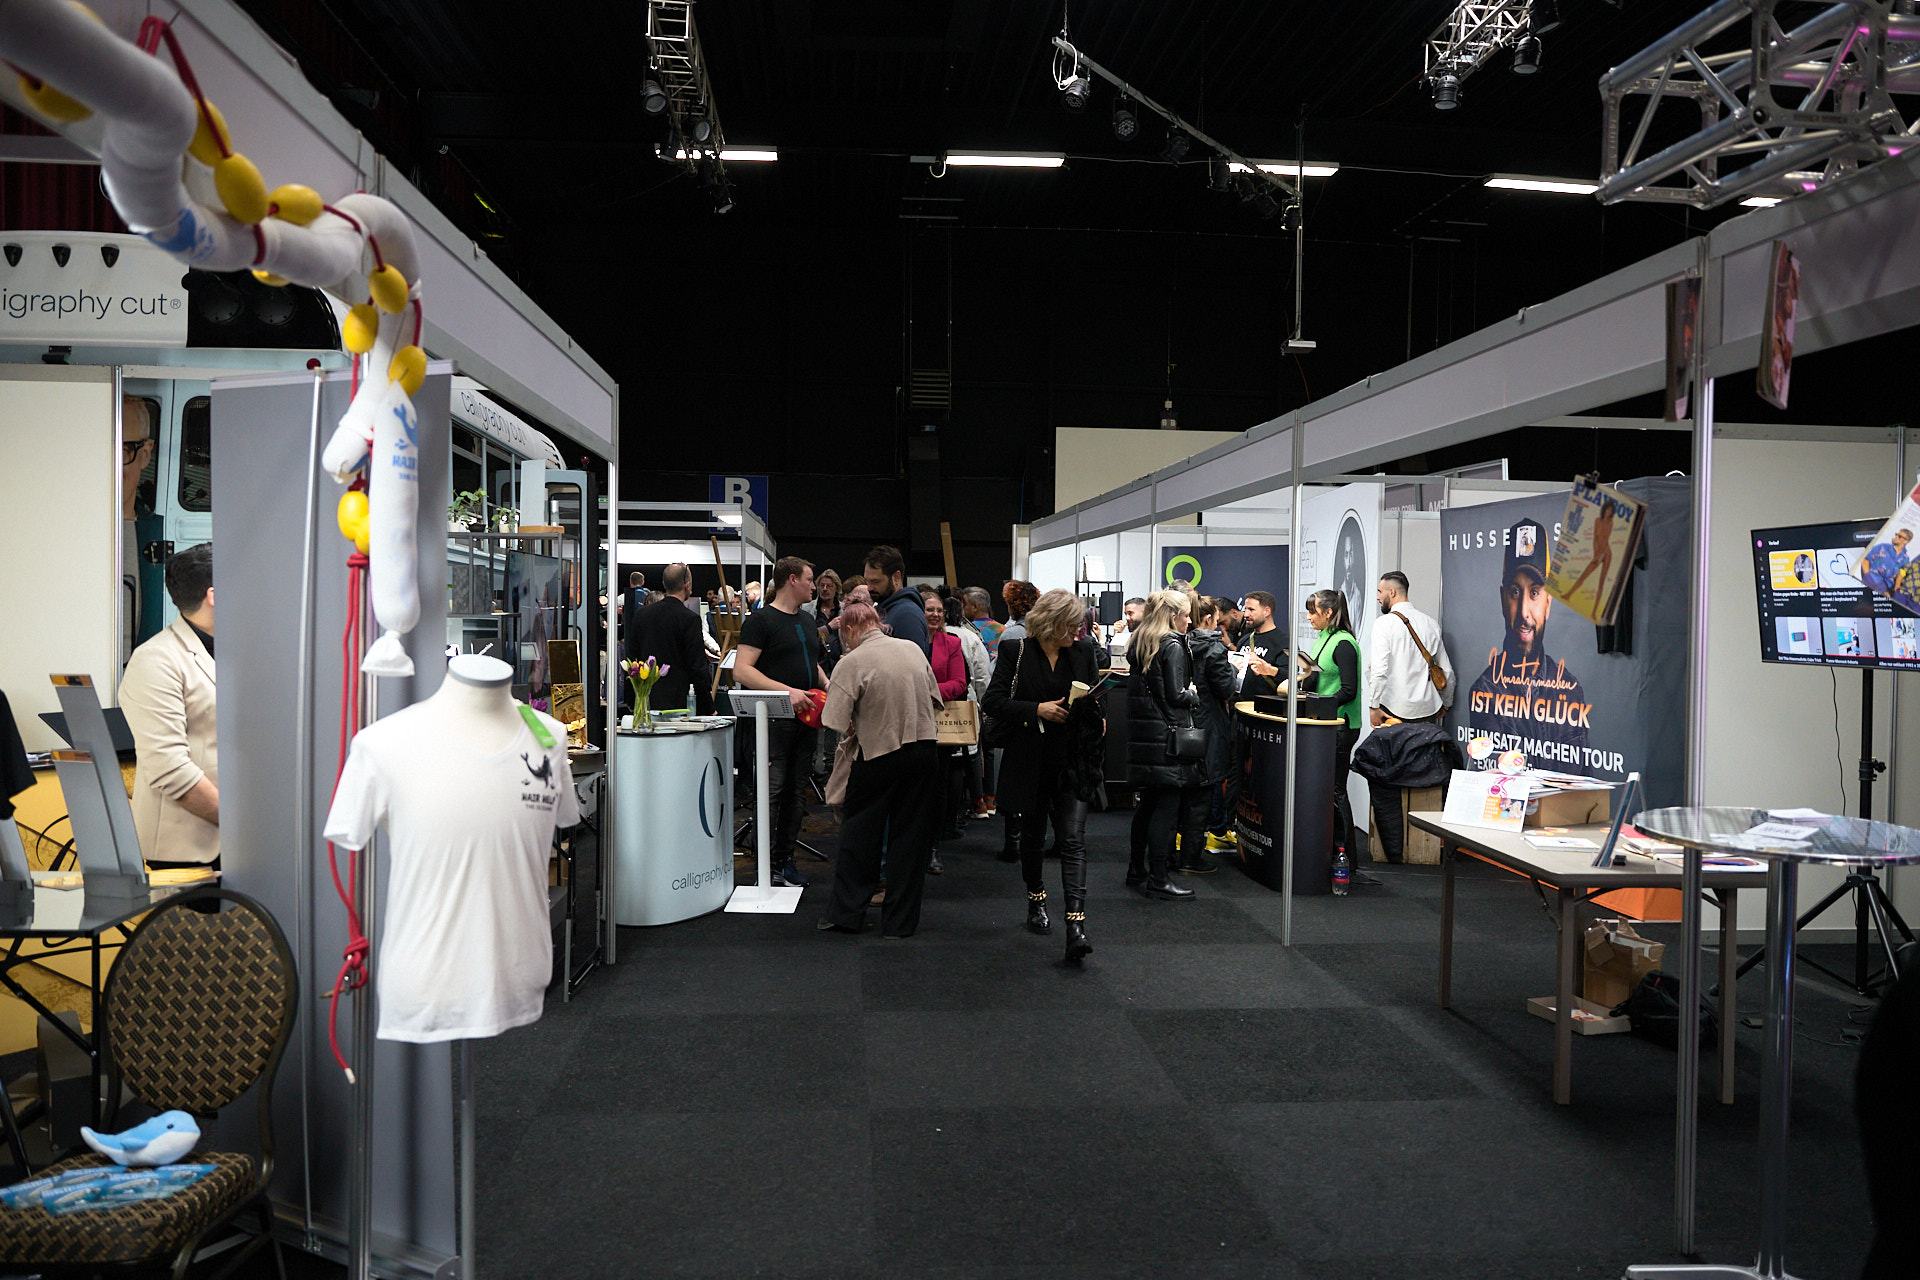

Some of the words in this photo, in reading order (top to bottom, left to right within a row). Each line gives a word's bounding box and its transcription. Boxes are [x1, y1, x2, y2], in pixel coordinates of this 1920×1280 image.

[2, 288, 112, 320] igraphy
[724, 477, 753, 513] B
[1449, 528, 1511, 551] HUSSE
[1471, 690, 1494, 714] IST
[1494, 692, 1531, 720] KEIN
[1533, 693, 1593, 728] GLÜCK
[1457, 725, 1475, 743] DIE
[1523, 736, 1580, 765] MACHEN
[1579, 748, 1624, 773] TOUR
[671, 864, 724, 891] calligraphy
